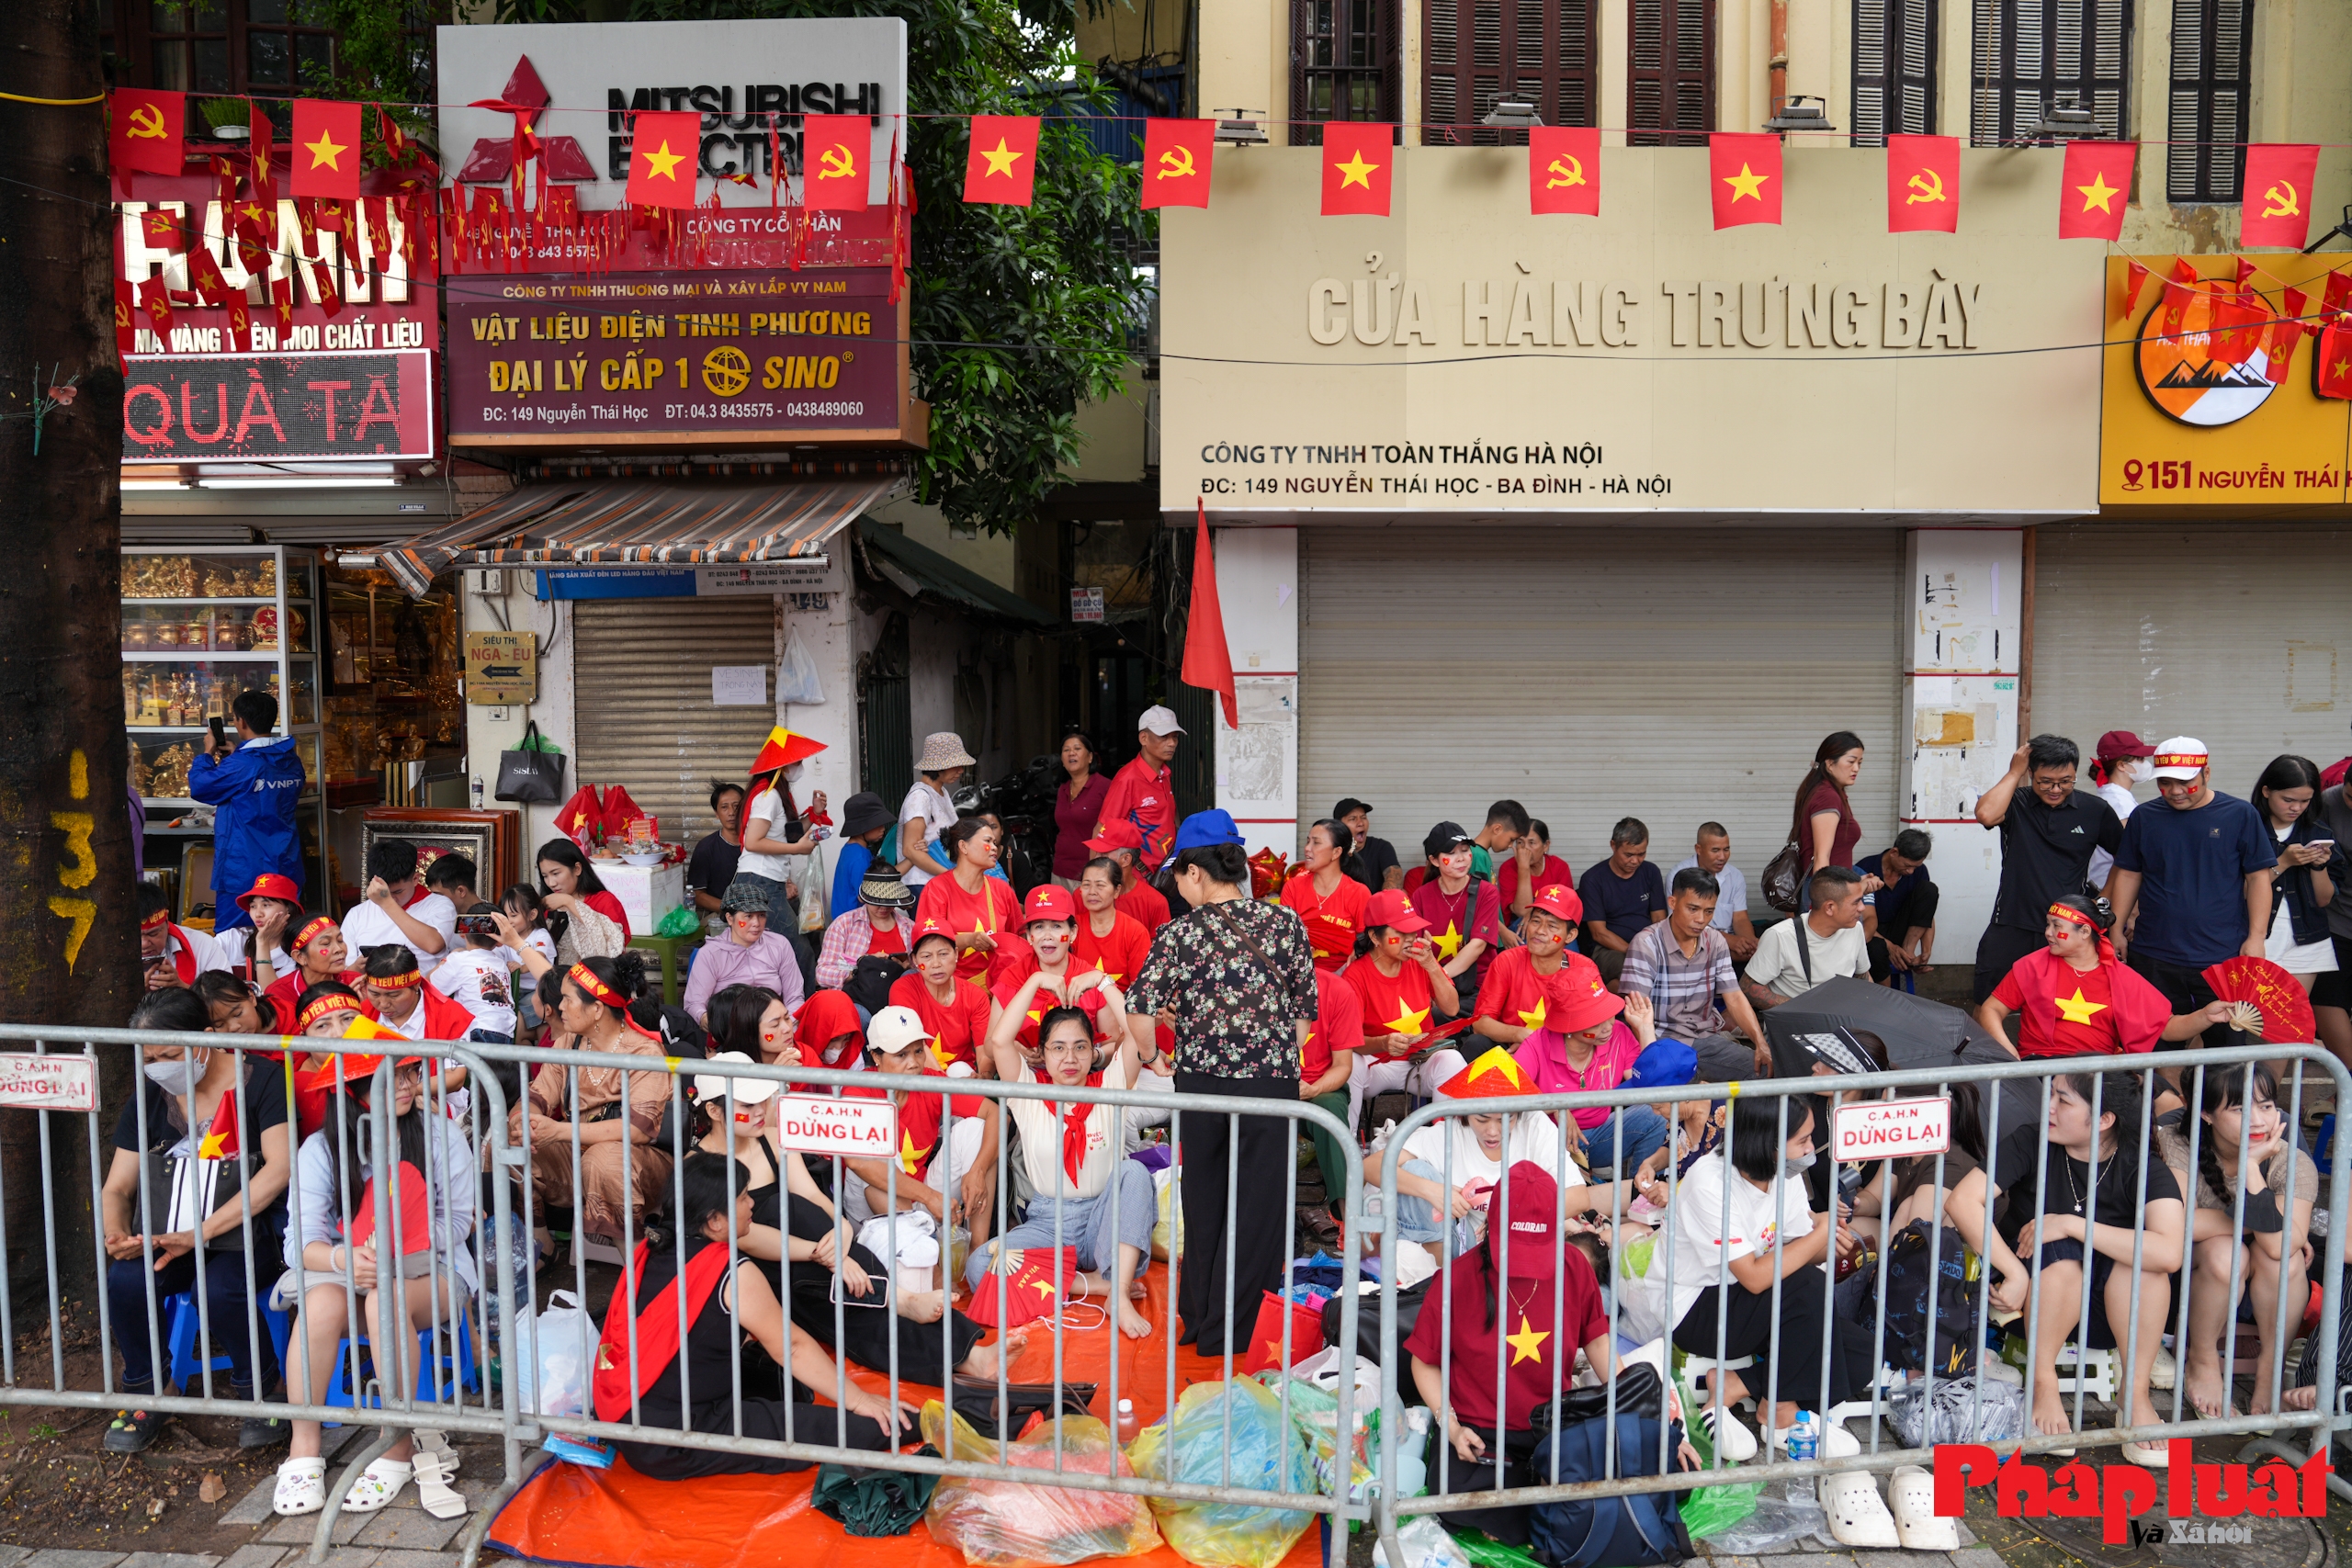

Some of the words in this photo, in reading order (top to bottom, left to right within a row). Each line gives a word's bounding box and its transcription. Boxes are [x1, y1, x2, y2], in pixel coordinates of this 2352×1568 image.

[608, 83, 879, 131] MITSUBISHI
[687, 215, 735, 234] CÔNG
[740, 218, 761, 232] TY
[765, 210, 790, 233] CỔ
[503, 283, 547, 299] CÔNG
[551, 286, 566, 298] TY
[570, 285, 607, 297] TNHH
[673, 283, 699, 299] MẠI
[704, 278, 723, 295] VÀ
[728, 280, 756, 294] XÂY
[760, 276, 786, 294] LẮP
[790, 282, 808, 294] VY
[813, 281, 846, 293] NAM
[1308, 250, 1437, 346] CỬA
[1463, 260, 1640, 347] HÀNG
[1663, 275, 1870, 348] TRƯNG
[1882, 267, 1984, 349] BÀY
[171, 323, 220, 353] VÀNG
[324, 314, 375, 349] CHẤT
[382, 317, 423, 349] LIỆU
[471, 312, 520, 346] VẬT
[530, 310, 591, 344] LIỆU
[600, 309, 667, 344] ĐIỆN
[675, 312, 740, 337] TINH
[750, 310, 871, 336] PHƯƠNG
[489, 359, 543, 399] ĐẠI
[555, 351, 589, 391] LÝ
[600, 348, 664, 391] CẤP
[674, 357, 689, 389] 1
[123, 369, 286, 446] QUÀ
[483, 407, 507, 422] ĐC:
[512, 406, 534, 422] 149
[537, 402, 586, 424] Nguyễn
[591, 404, 619, 420] Thái
[623, 404, 649, 423] Học
[665, 404, 688, 419] ĐT:
[690, 403, 717, 419] 04.3
[720, 403, 774, 418] 8435575
[786, 400, 864, 417] 0438489060
[1201, 441, 1265, 463] CÔNG
[1271, 446, 1298, 464] TY
[1303, 445, 1366, 463] TNHH
[1372, 441, 1433, 464] TOÀN
[1439, 437, 1518, 465] THẮNG
[1525, 442, 1556, 464] HÀ
[1563, 442, 1602, 468] NỘI
[1201, 478, 1236, 493] ĐC:
[1245, 478, 1278, 493] 149
[1285, 469, 1373, 493] NGUYỄN
[1380, 473, 1427, 493] THÁI
[1436, 478, 1479, 497] HỌC
[1498, 478, 1526, 493] BA
[1532, 473, 1582, 493] ĐÌNH
[1602, 474, 1630, 493] HÀ
[1637, 474, 1671, 497] NỘI
[2147, 460, 2192, 490] 151
[2199, 462, 2285, 489] NGUYỄN
[2294, 462, 2339, 488] THÁI
[483, 635, 502, 645] SIÊU
[503, 637, 517, 648] THỊ
[471, 648, 502, 661] NGA
[513, 648, 531, 661] EU
[2182, 755, 2195, 766] VIỆT
[266, 779, 301, 789] VNPT
[1336, 917, 1352, 929] NAM
[2056, 907, 2073, 918] NAM
[299, 931, 310, 942] TÔI
[305, 922, 319, 936] YÊU
[394, 974, 408, 987] VIỆT
[579, 971, 598, 989] NAM
[301, 1011, 311, 1026] TÔI
[309, 1000, 326, 1015] YÊU
[325, 995, 346, 1009] VIỆT
[52, 1081, 85, 1100] LẠI
[810, 1105, 862, 1117] C.A.H.N
[1868, 1108, 1918, 1121] C.A.H.N
[786, 1116, 847, 1140] DỪNG
[852, 1124, 888, 1145] LẠI
[1843, 1124, 1903, 1146] DỪNG
[1907, 1123, 1941, 1143] LẠI
